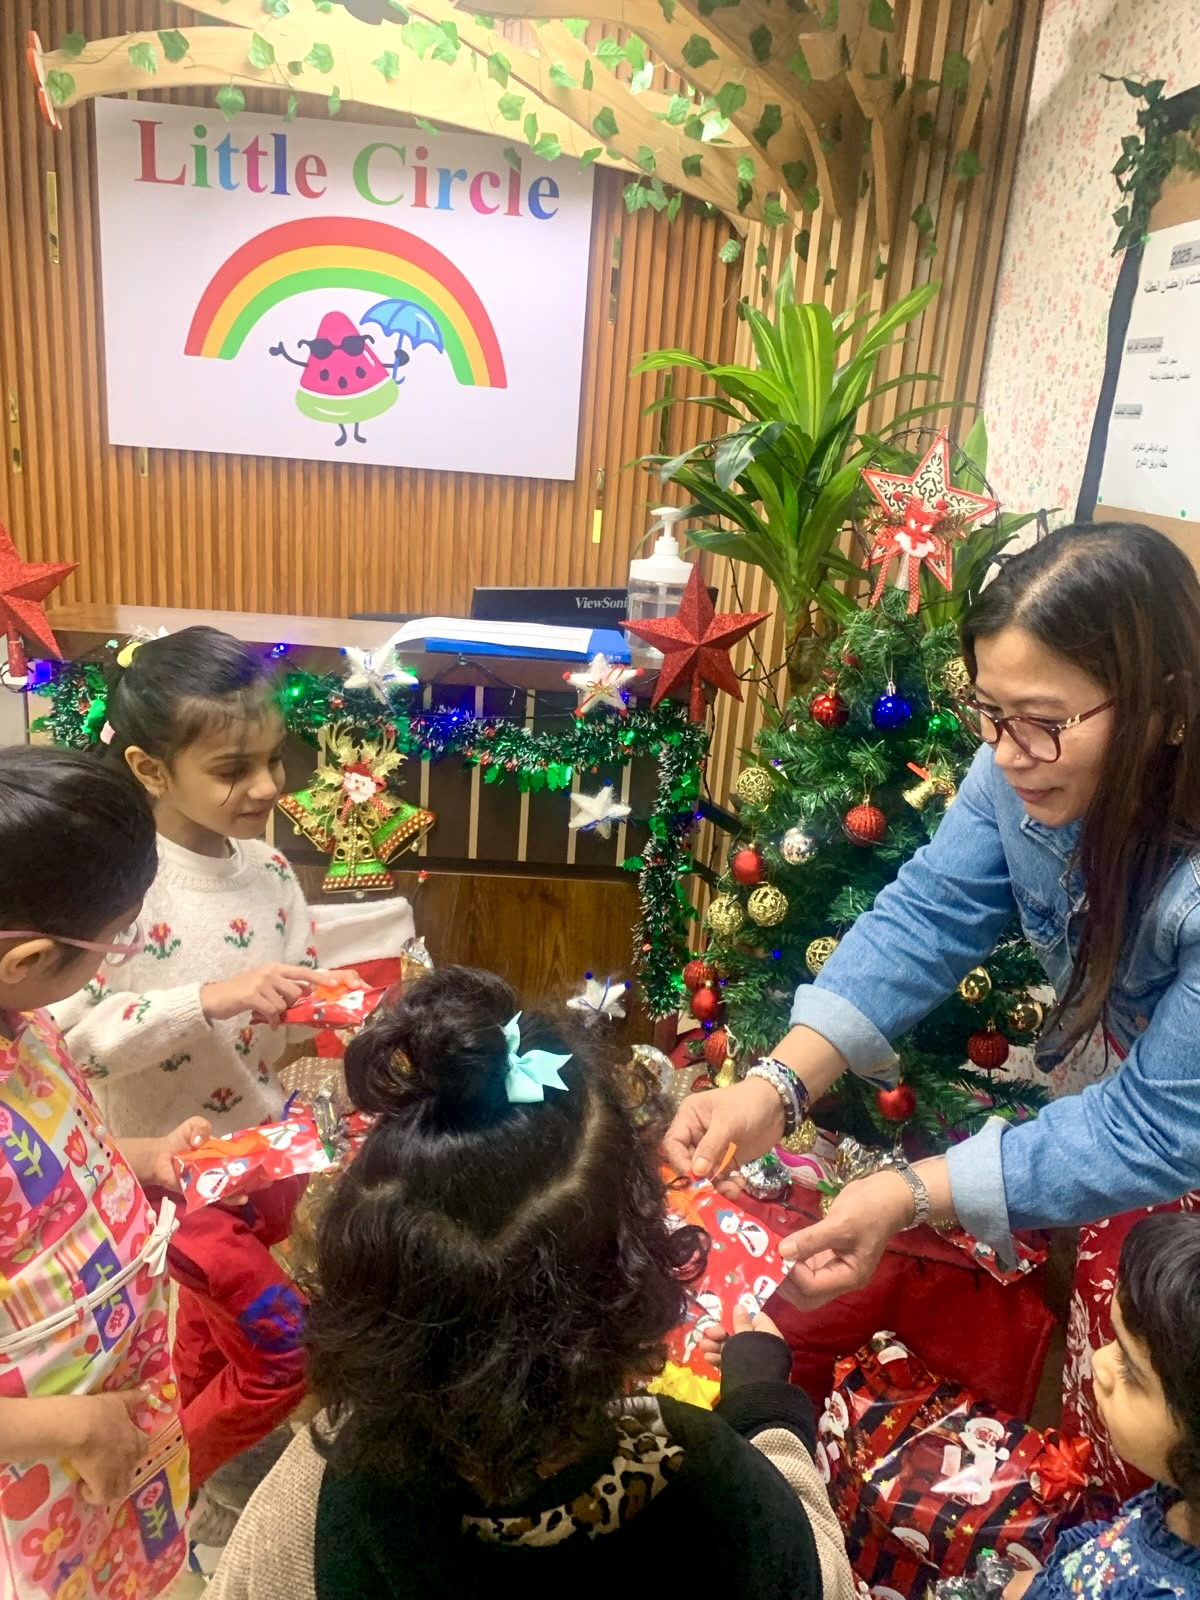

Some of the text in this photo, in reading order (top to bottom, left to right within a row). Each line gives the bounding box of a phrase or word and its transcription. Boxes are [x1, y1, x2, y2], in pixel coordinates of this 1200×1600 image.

[133, 120, 561, 220] Little Circle
[575, 597, 629, 609] ViewSoni
